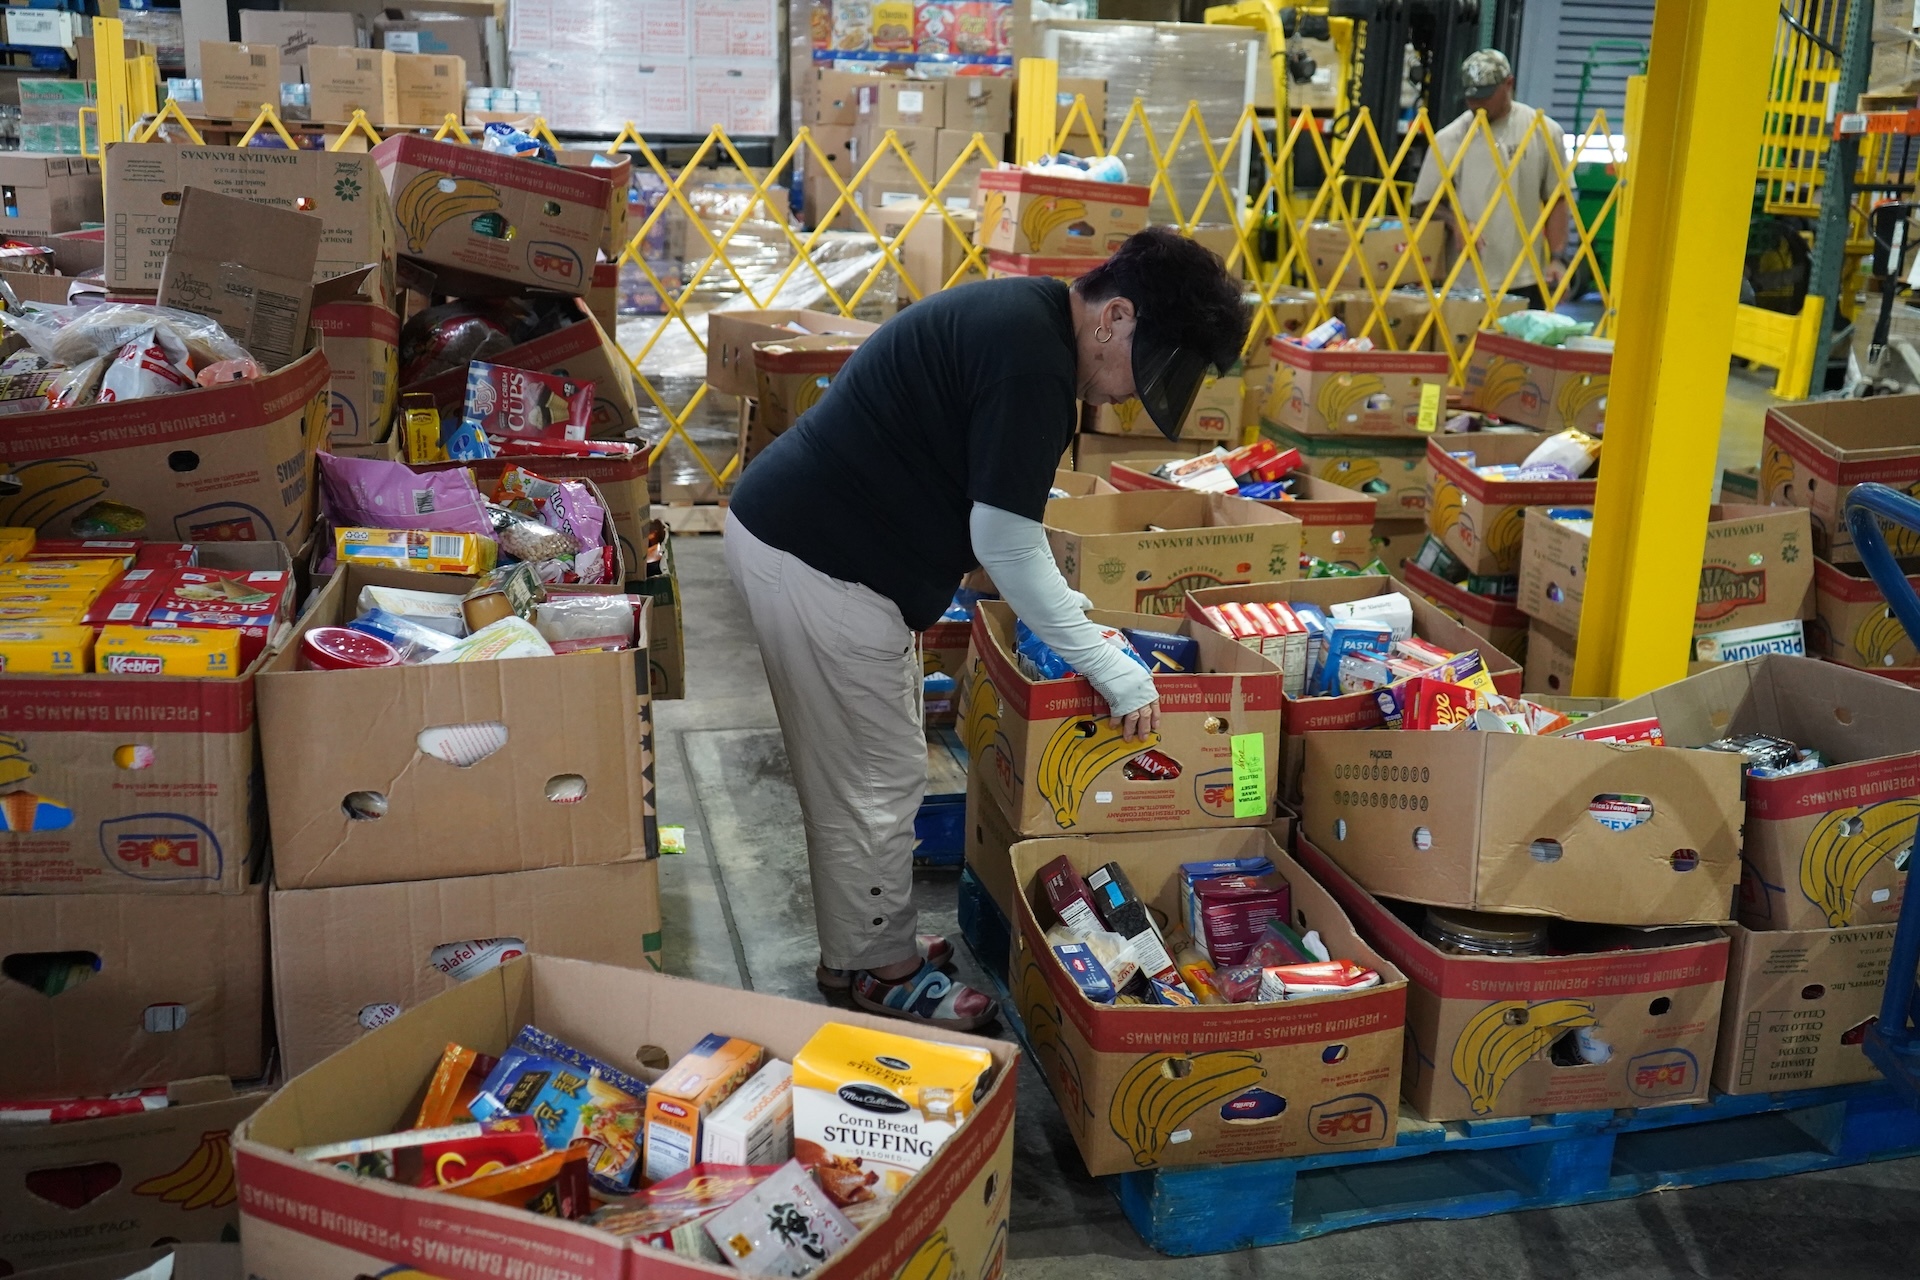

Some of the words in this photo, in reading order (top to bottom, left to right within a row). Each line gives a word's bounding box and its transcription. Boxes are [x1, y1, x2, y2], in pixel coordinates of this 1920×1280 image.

[1351, 19, 1368, 106] HYSTER
[181, 151, 236, 162] BANANAS
[239, 153, 298, 165] HAWAIIAN
[416, 153, 456, 171] BANANAS
[457, 160, 499, 177] PREMIUM
[504, 171, 544, 189] BANANAS
[546, 180, 585, 199] PREMIUM
[533, 256, 574, 278] Dole
[501, 372, 509, 399] CREAM
[472, 379, 498, 416] Joy
[507, 372, 525, 432] CUPS
[501, 400, 509, 412] ICE
[159, 412, 225, 434] PREMIUM
[88, 421, 156, 443] BANANAS
[9, 433, 76, 453] PREMIUM
[1197, 532, 1254, 546] HAWAIIAN
[1707, 523, 1765, 540] HAWAIIAN
[1138, 537, 1193, 550] BANANAS
[165, 602, 270, 611] SUGAR
[1153, 641, 1175, 651] PENNE
[1343, 640, 1375, 650] PASTA
[1722, 637, 1804, 661] PREMIUM
[52, 651, 72, 663] 12
[109, 655, 161, 674] Keebler
[206, 652, 227, 664] 12
[1049, 693, 1093, 711] BANANAS
[1158, 693, 1203, 705] BANANA
[21, 705, 108, 721] BANANAS
[113, 705, 199, 721] PREMIUM
[1309, 713, 1356, 728] BANANAS
[1369, 750, 1393, 760] PACKER
[1860, 775, 1915, 796] PREMIUM
[1203, 785, 1234, 808] ole
[1801, 785, 1858, 807] BANANAS
[1137, 810, 1155, 818] FRUIT
[1155, 809, 1174, 817] FRESH
[1590, 801, 1610, 811] erica's
[1610, 803, 1636, 813] Favorite
[1106, 811, 1137, 819] COMPANY
[117, 837, 199, 868] Dole
[1829, 930, 1885, 944] BANANAS
[1597, 972, 1651, 988] BANANAS
[1653, 965, 1701, 983] PREMIUM
[1472, 979, 1531, 993] BANANAS
[1531, 977, 1589, 991] PREMIUM
[1830, 982, 1847, 991] Inc.
[1848, 978, 1886, 989] Growers,
[1793, 1009, 1826, 1019] CELLO
[1326, 1012, 1382, 1033] PREMIUM
[1791, 1021, 1823, 1031] CELLO
[1193, 1029, 1256, 1044] PREMIUM
[1264, 1021, 1324, 1040] BANANAS
[1126, 1031, 1191, 1046] BANANAS
[1781, 1034, 1822, 1044] SINGLES
[1778, 1046, 1818, 1056] CUSTOM
[1770, 1061, 1782, 1069] #2
[1781, 1058, 1816, 1068] HAWAII
[1635, 1065, 1687, 1089] Dole
[1769, 1072, 1780, 1081] #1
[1779, 1069, 1814, 1080] HAWAII
[659, 1102, 687, 1118] Barilla
[1231, 1100, 1257, 1109] Barilla
[838, 1112, 873, 1129] Corn
[877, 1118, 918, 1136] Bread
[1316, 1112, 1372, 1138] Dole
[649, 1142, 671, 1155] Calories
[823, 1125, 934, 1158] STUFFING
[855, 1148, 903, 1162] SEASONED
[1197, 1147, 1234, 1155] COMPANY
[241, 1184, 319, 1225] BANANAS
[320, 1210, 402, 1252] PREMIUM
[411, 1236, 502, 1276] BANANAS
